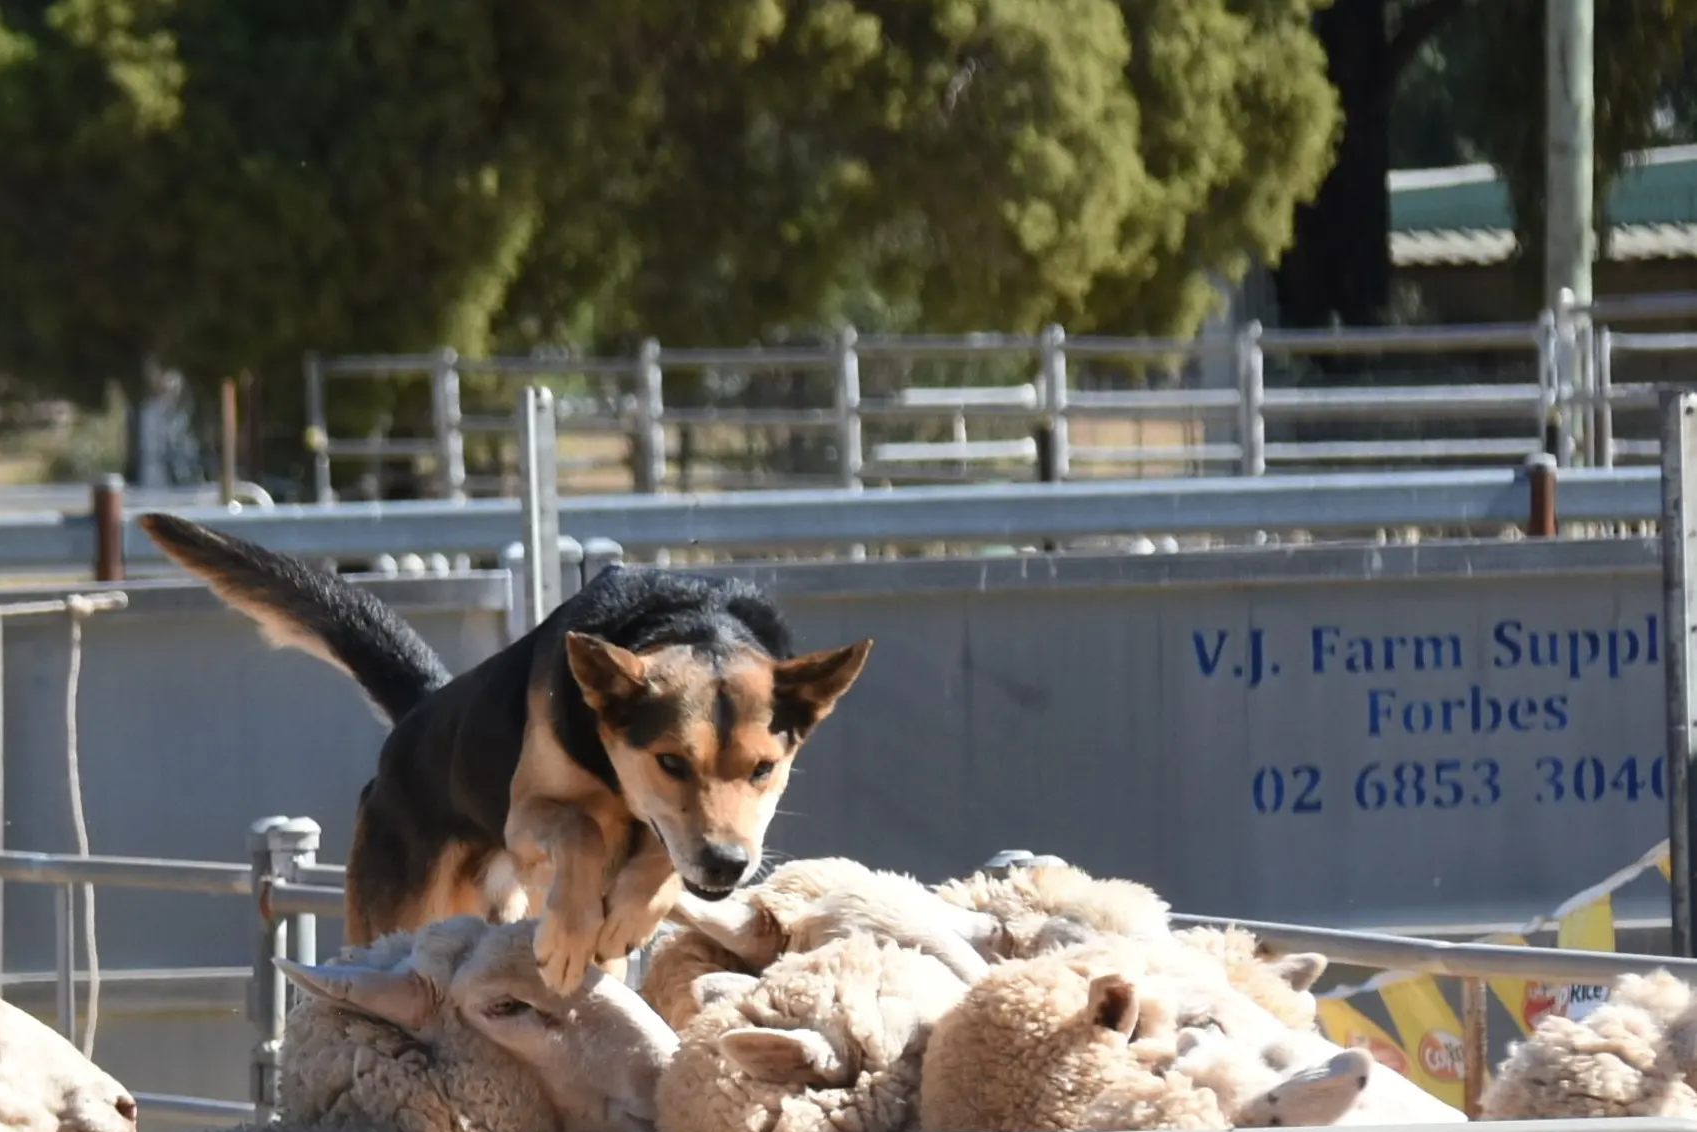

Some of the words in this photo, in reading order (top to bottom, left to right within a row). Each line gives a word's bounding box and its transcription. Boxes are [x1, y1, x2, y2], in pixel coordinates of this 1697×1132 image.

[1191, 627, 1281, 688] V.J.
[1311, 624, 1463, 675] Farm
[1492, 613, 1660, 678] Suppl
[1367, 684, 1569, 737] Forbes
[1252, 764, 1324, 814] 02
[1354, 757, 1502, 811] 6853
